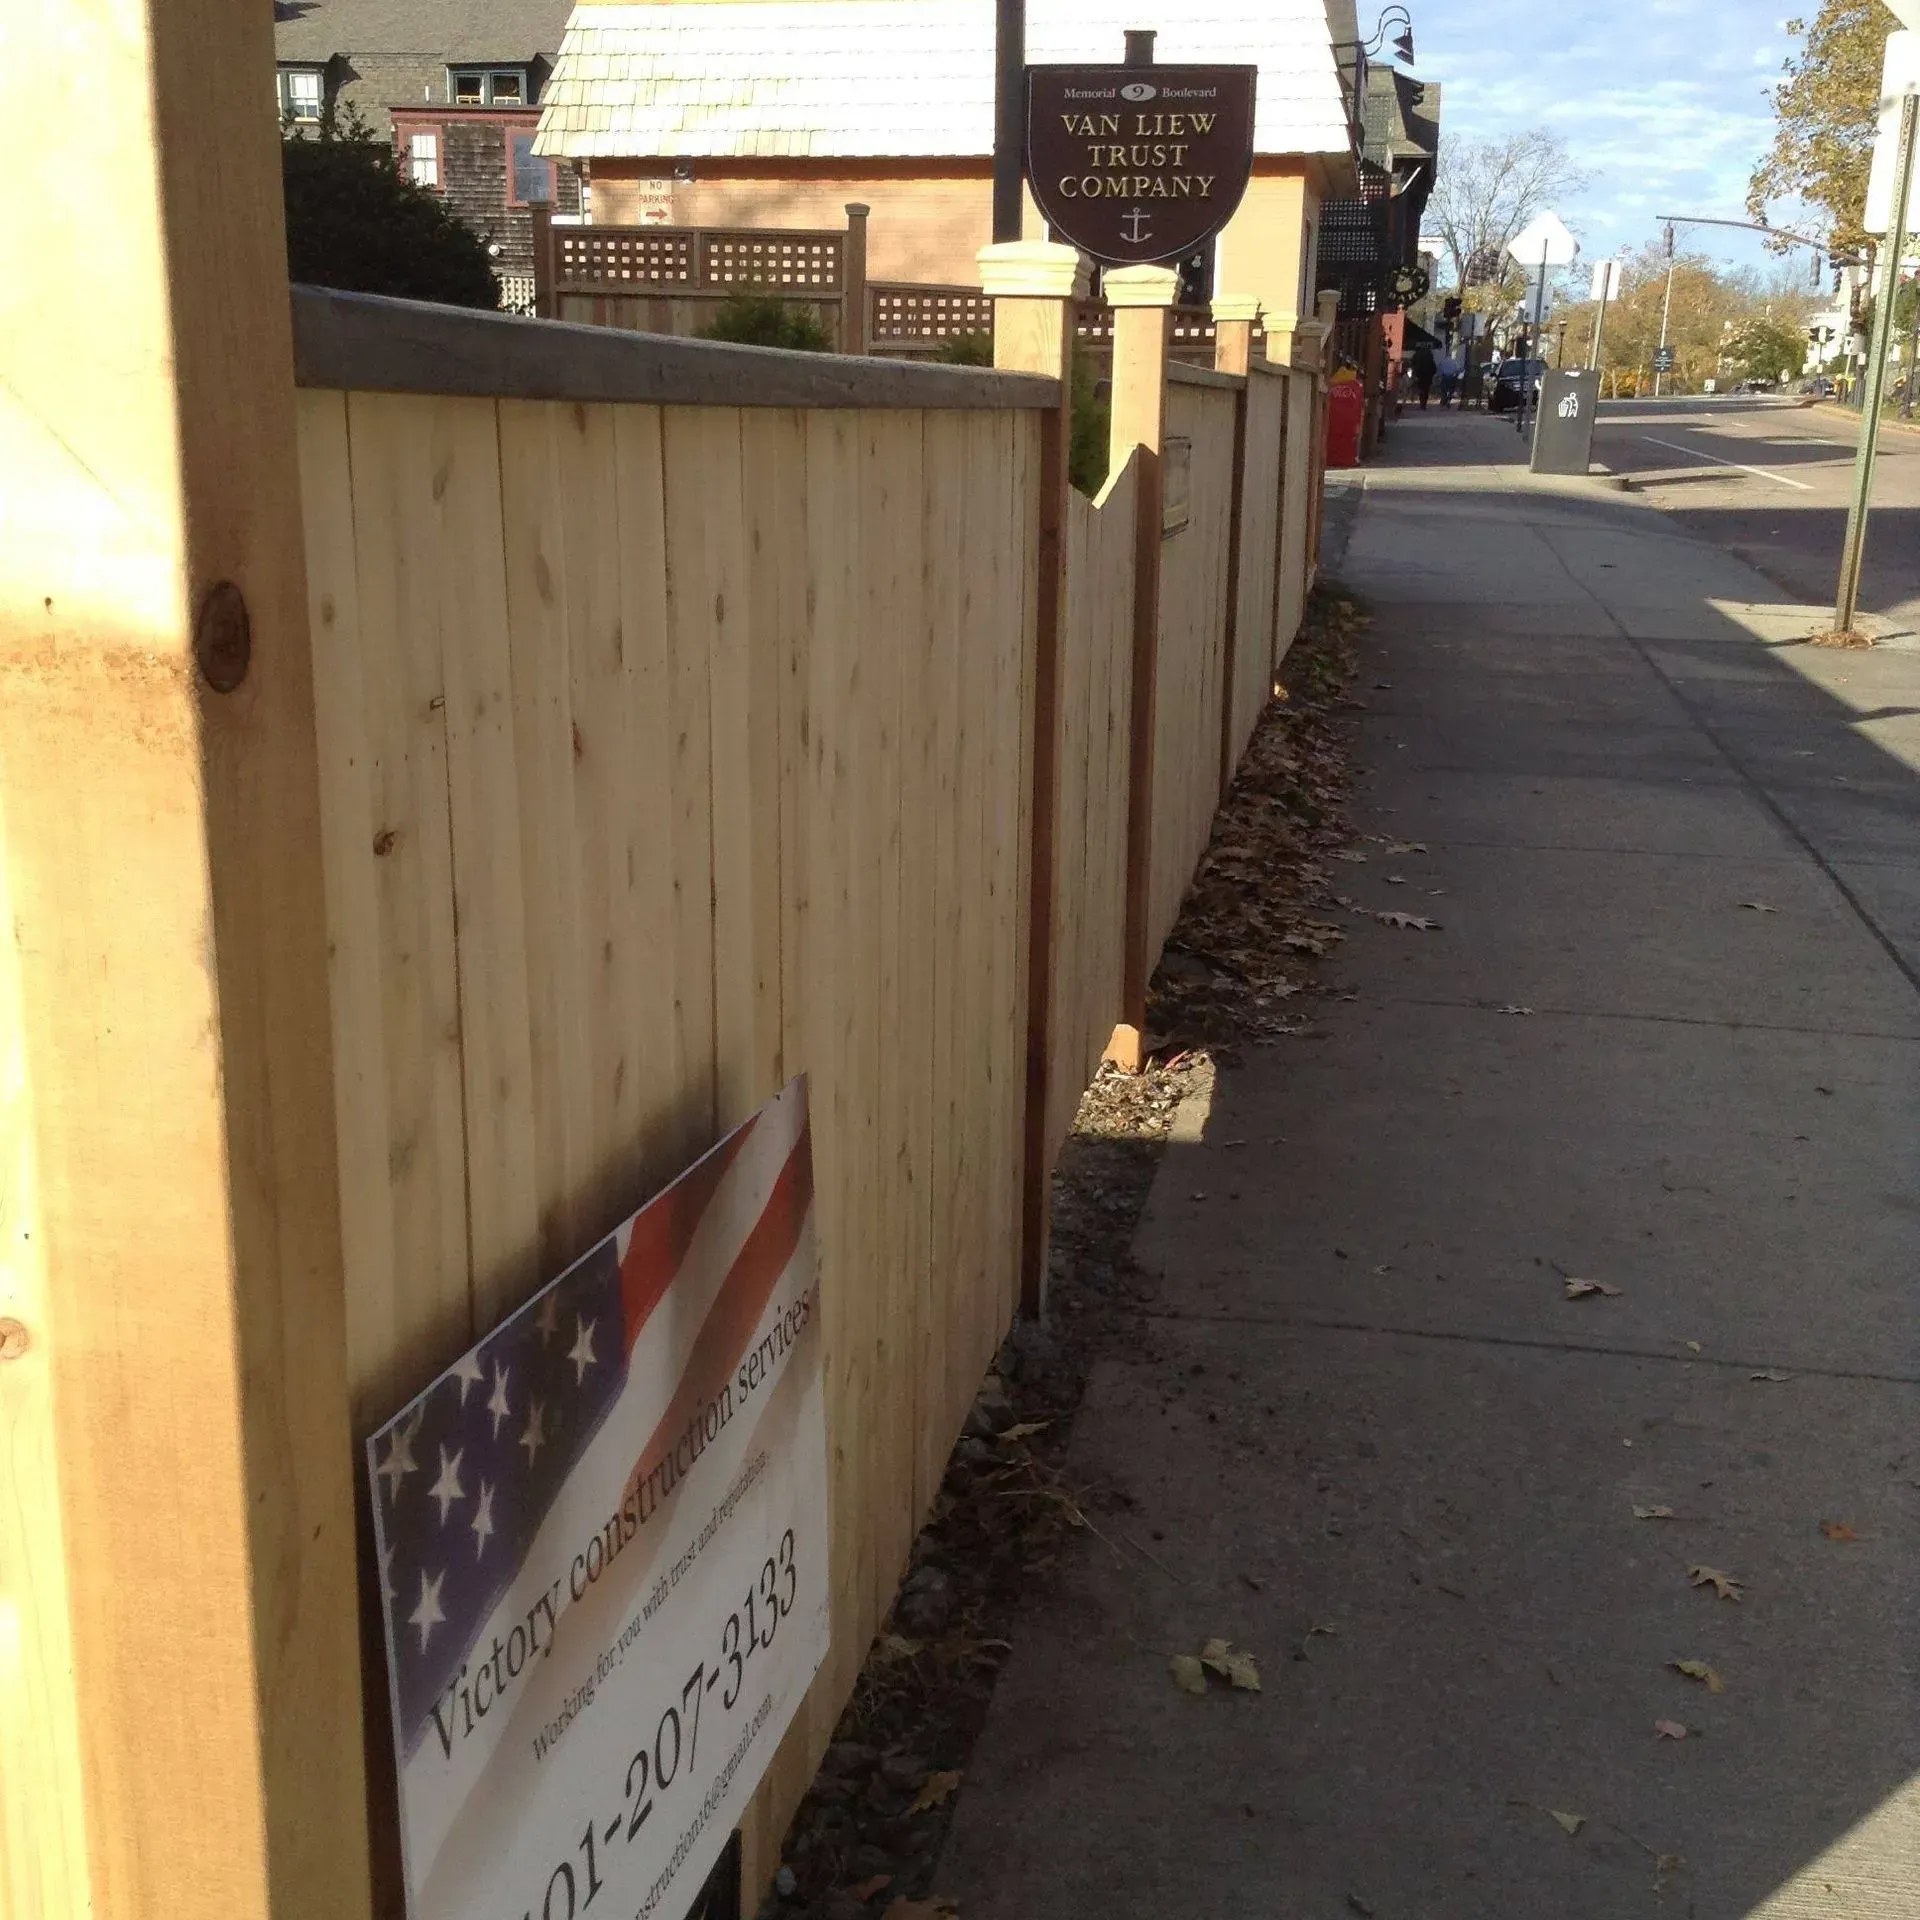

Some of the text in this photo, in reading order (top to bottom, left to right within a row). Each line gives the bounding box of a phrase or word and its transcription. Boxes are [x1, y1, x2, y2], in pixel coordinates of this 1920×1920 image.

[1064, 87, 1116, 99] Memorial
[1162, 87, 1217, 99] Boulevard
[1061, 113, 1216, 136] VAN LIEW
[1088, 145, 1188, 167] TRUST
[649, 181, 662, 190] NO
[1059, 176, 1216, 198] COMPANY
[640, 194, 674, 204] PARKING
[430, 1288, 811, 1761] Victory construction services
[532, 1676, 596, 1761] Working
[597, 1648, 615, 1684] for
[618, 1623, 642, 1665] you
[643, 1576, 669, 1620] with
[671, 1541, 696, 1588] trust
[698, 1506, 718, 1552] and
[524, 1527, 796, 1920] 01-207-3133
